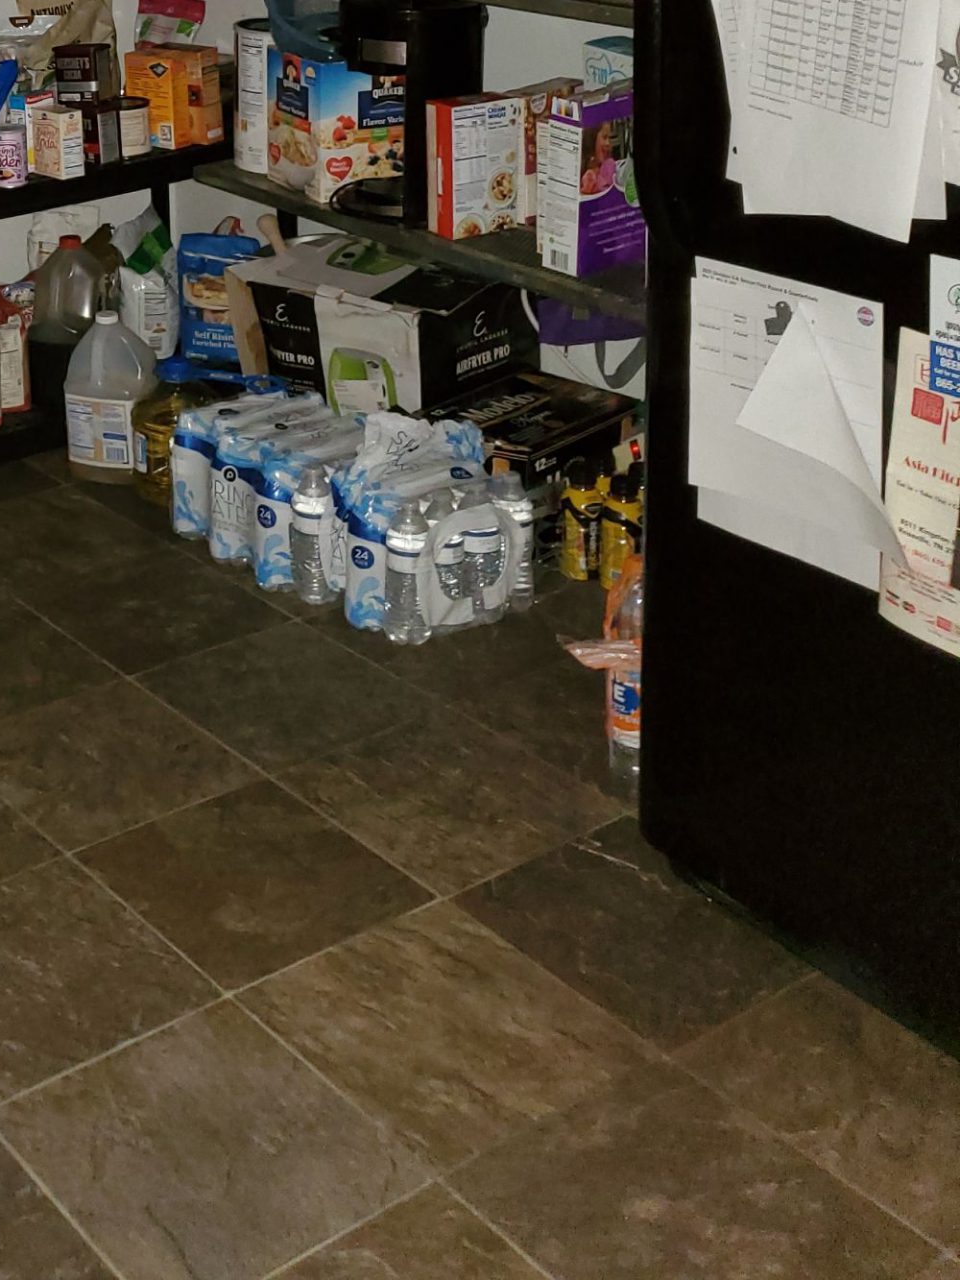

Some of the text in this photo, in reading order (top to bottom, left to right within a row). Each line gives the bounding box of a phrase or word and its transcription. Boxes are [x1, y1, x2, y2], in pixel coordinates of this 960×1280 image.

[372, 86, 405, 100] QUAKER
[362, 117, 386, 128] Flavor
[296, 353, 316, 366] PRO
[456, 344, 511, 375] AIRFRYER PRO
[534, 457, 547, 472] 12
[903, 456, 929, 476] Asia
[258, 507, 272, 521] 24
[354, 549, 369, 561] 24
